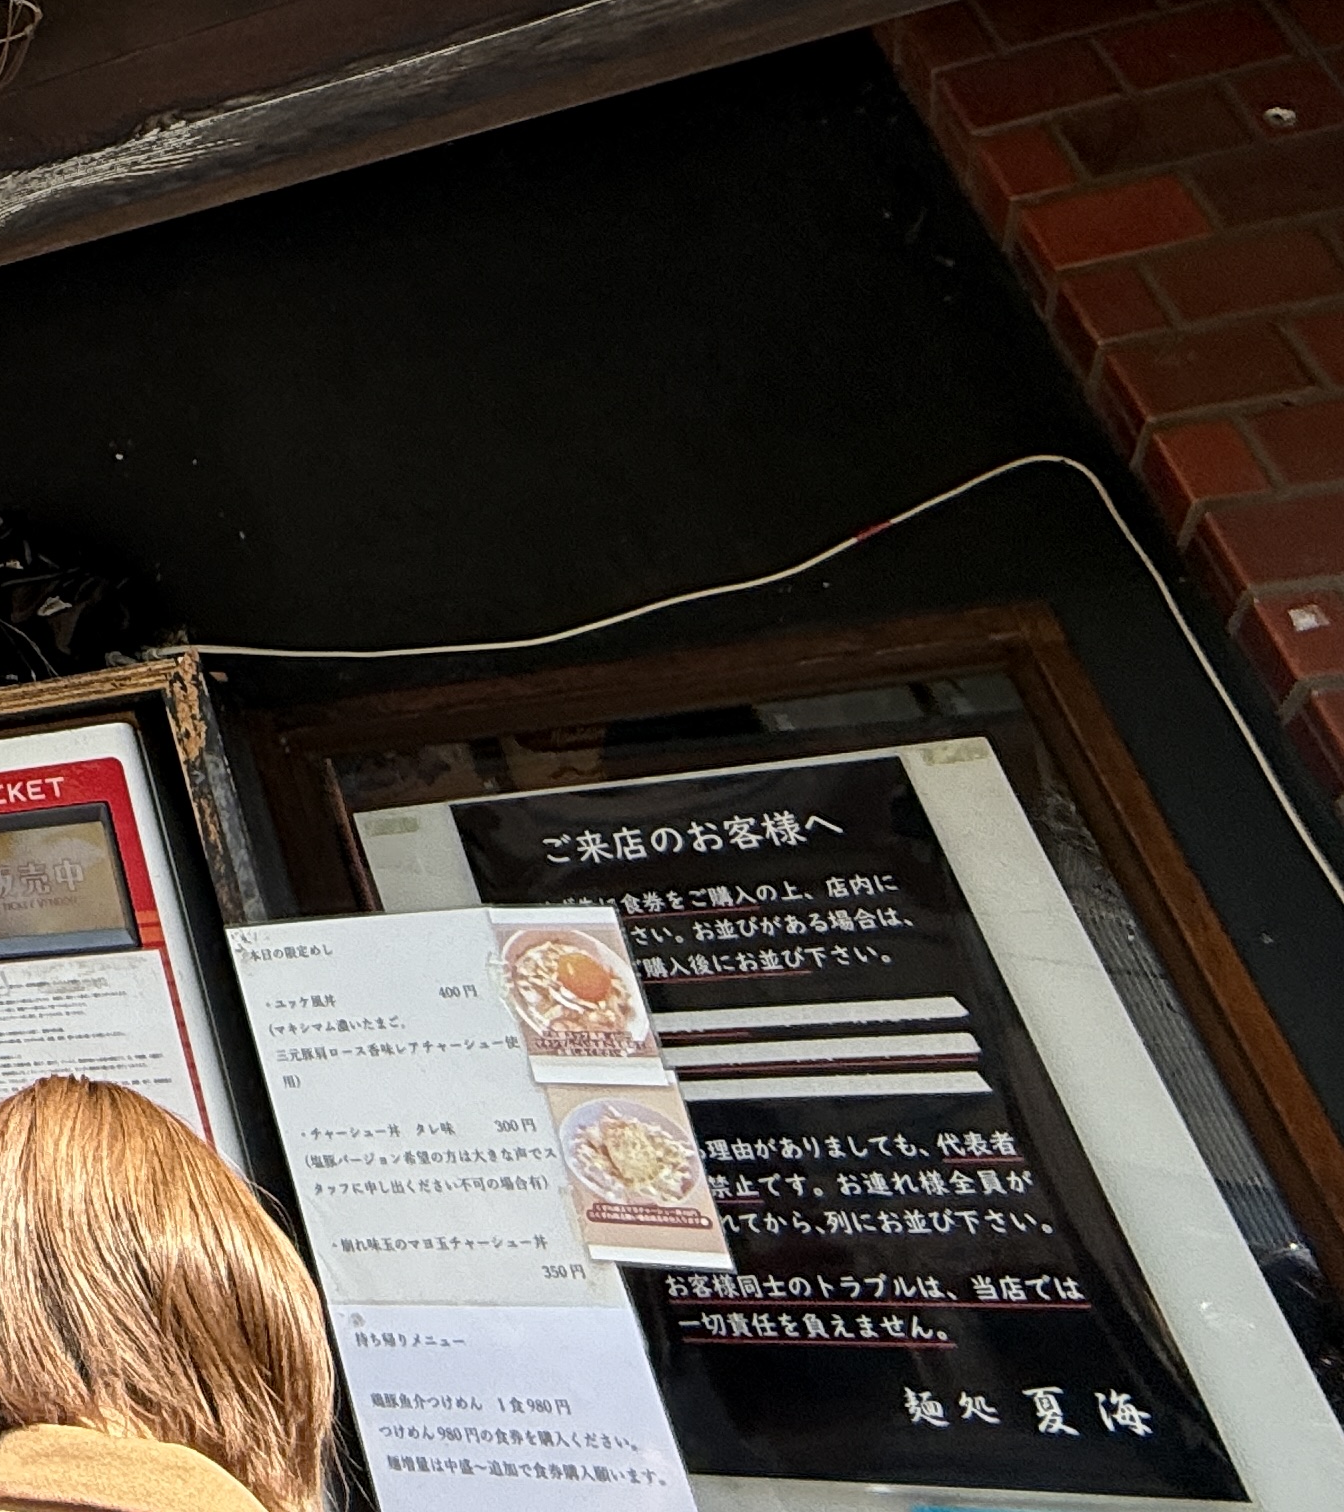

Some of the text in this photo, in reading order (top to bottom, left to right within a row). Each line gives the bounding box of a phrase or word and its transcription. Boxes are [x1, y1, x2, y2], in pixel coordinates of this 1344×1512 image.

[542, 808, 843, 866] ご来店のお客様へ
[546, 872, 899, 916] 食券をご購入の上、店内に
[248, 943, 333, 963] 本日の限定めし
[438, 984, 478, 1000] 400円
[415, 1121, 456, 1137] タレ味
[494, 1118, 537, 1135] 300円
[698, 1130, 1016, 1163] 理由がありましても、代表者
[541, 1264, 587, 1281] 350円
[667, 1272, 1086, 1303] お客様同士のトラブルは、当店では
[354, 1332, 466, 1349] 持ち帰りメニュー
[678, 1313, 950, 1343] 一切責任を負えません。
[370, 1391, 571, 1417] 鶏豚魚介つけめん 1食980円
[904, 1384, 1154, 1438] 麺処 夏海
[377, 1423, 640, 1454] つけめん980円の食券を購入ください。
